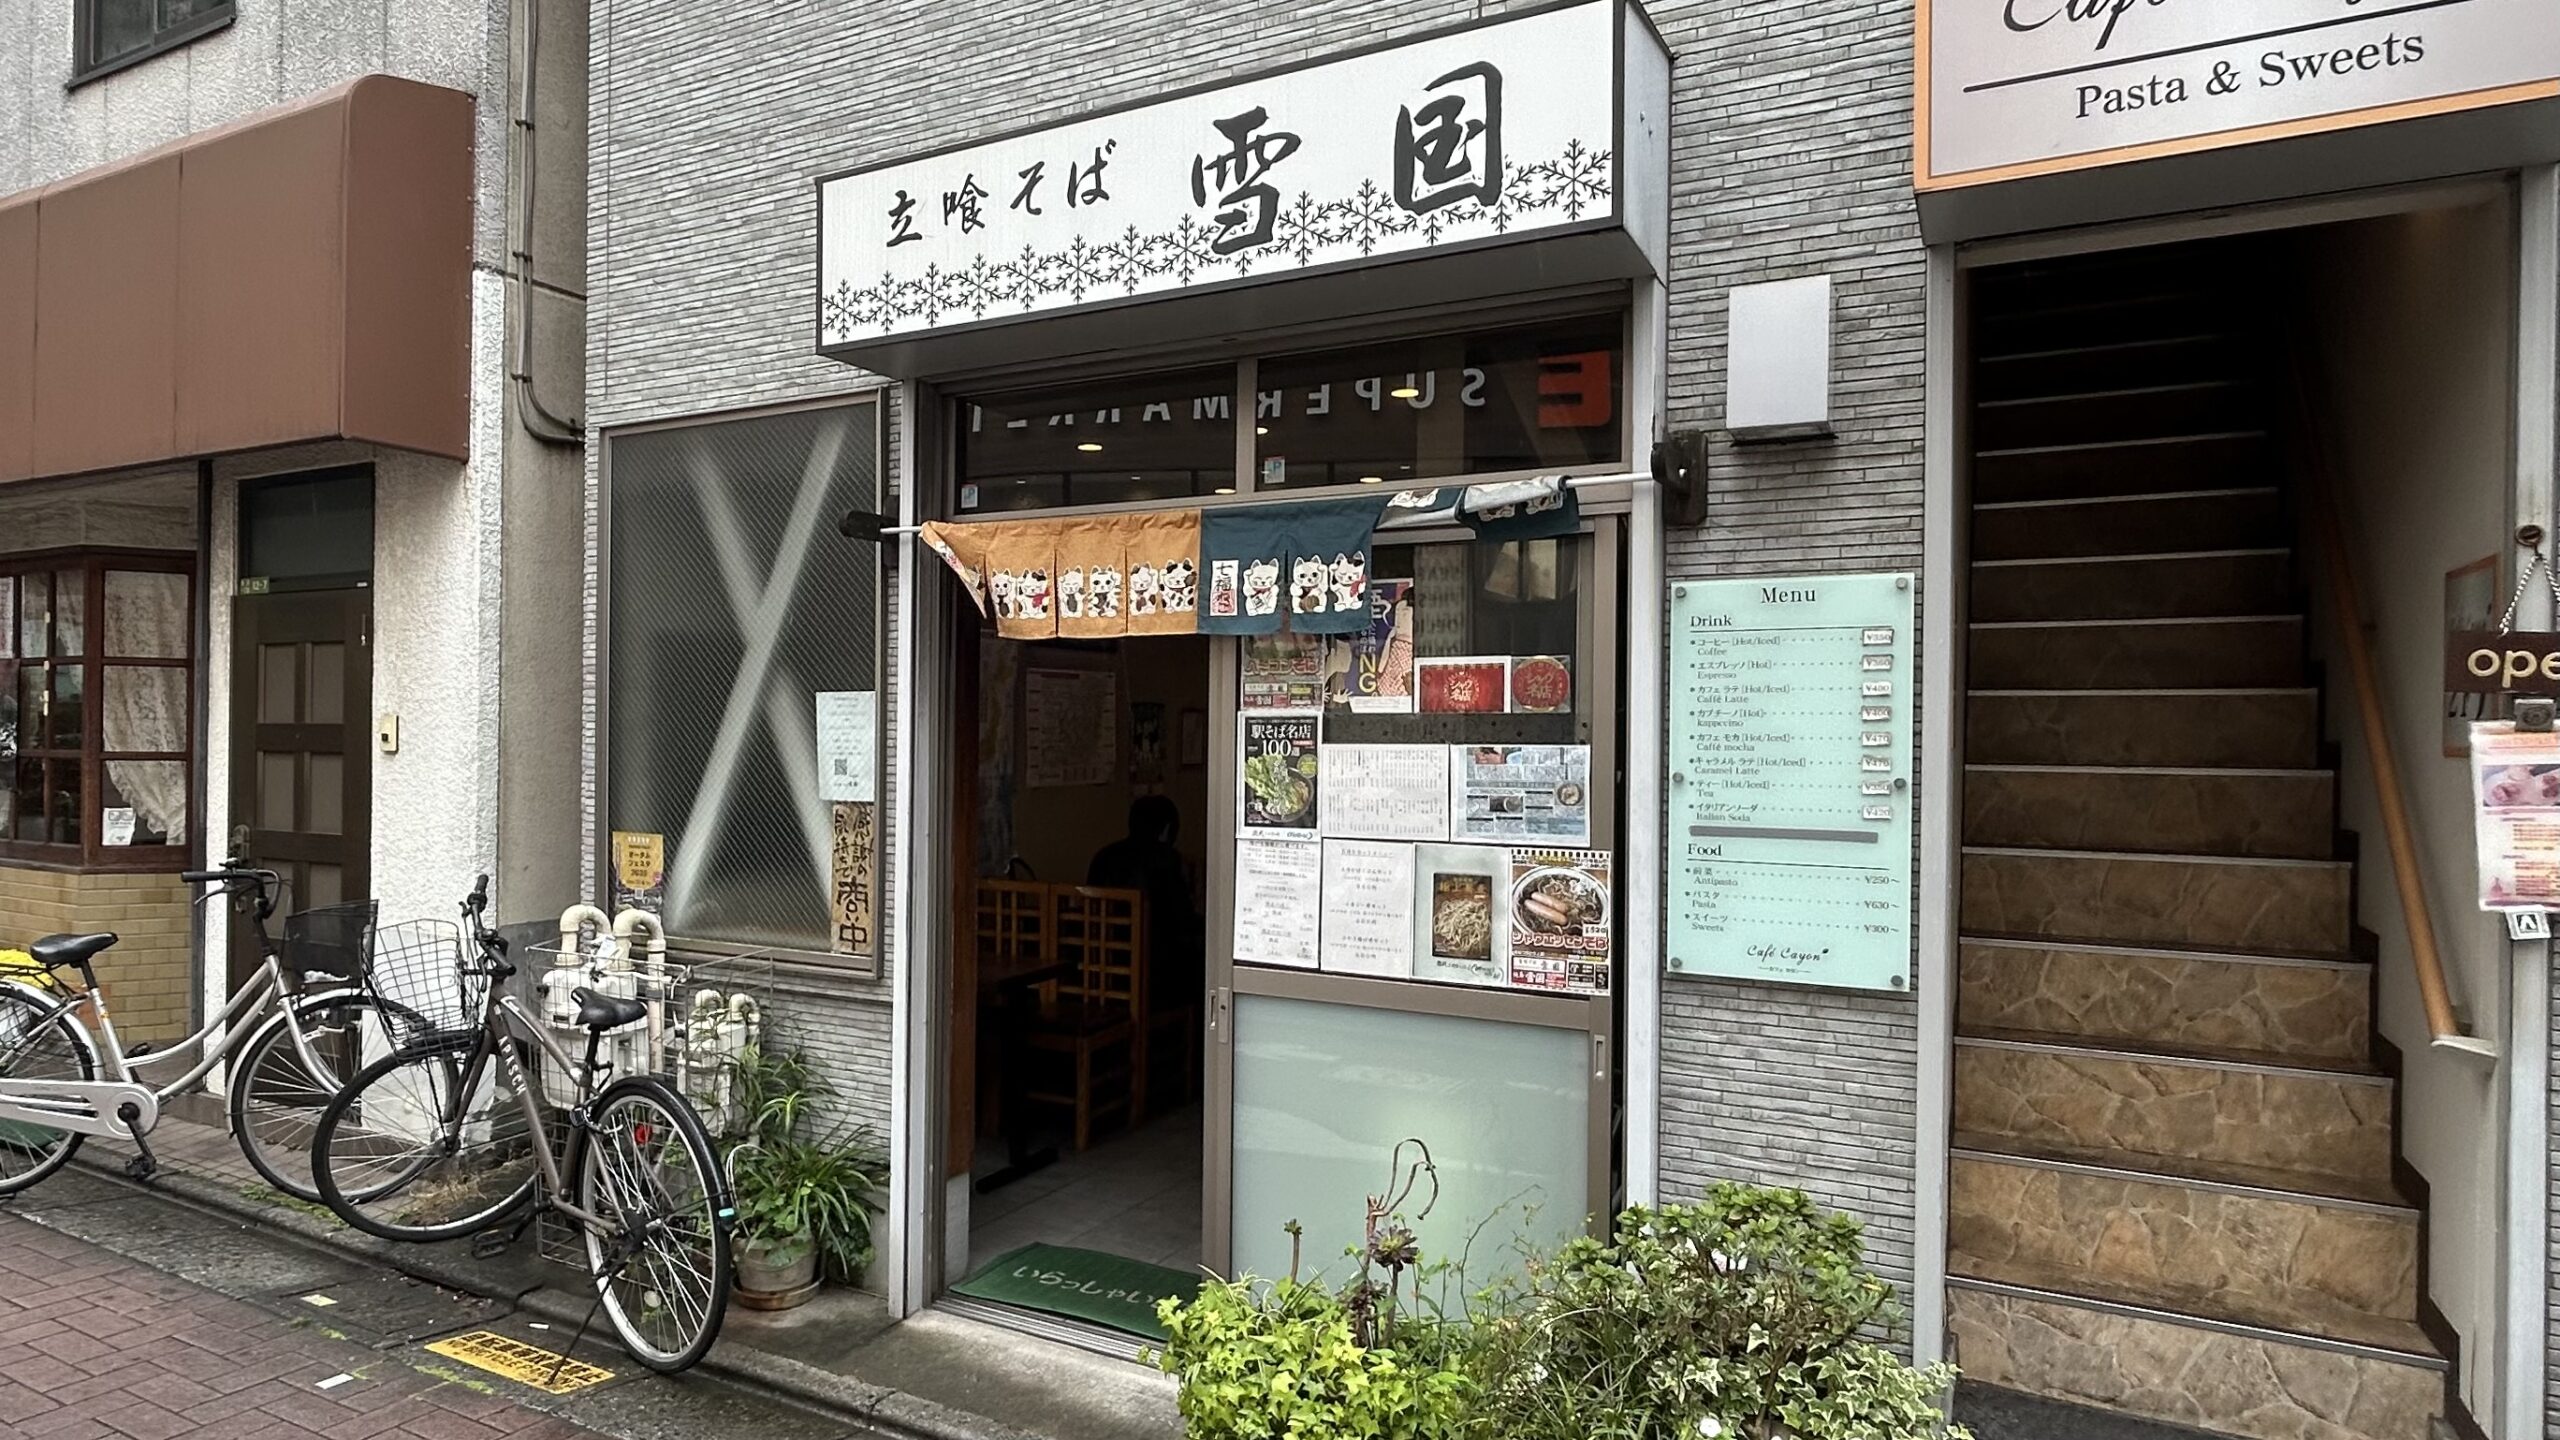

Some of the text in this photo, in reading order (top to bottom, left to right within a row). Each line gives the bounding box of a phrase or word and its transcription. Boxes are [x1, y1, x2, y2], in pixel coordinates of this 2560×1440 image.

[2075, 32, 2425, 119] Pasta & Sweets
[886, 60, 1504, 255] 立喰そば 雪国
[1761, 586, 1816, 603] Menu
[1691, 615, 1732, 627] Drink
[1697, 648, 1727, 656] Coffee
[1697, 671, 1737, 680] Espresso
[1725, 695, 1749, 703] Latte
[1251, 725, 1312, 740] 駅そば名店
[1724, 742, 1755, 751] mocha
[1694, 766, 1761, 775] Caramel Latte
[1696, 788, 1714, 797] Tea
[1696, 812, 1751, 822] Italian Soda
[1688, 843, 1722, 856] Food
[1694, 876, 1738, 886] Antipasto
[1692, 900, 1716, 908] Pasta
[1692, 922, 1724, 931] Sweets
[1747, 944, 1777, 963] Café
[1013, 1266, 1158, 1308] いらっしゃい
